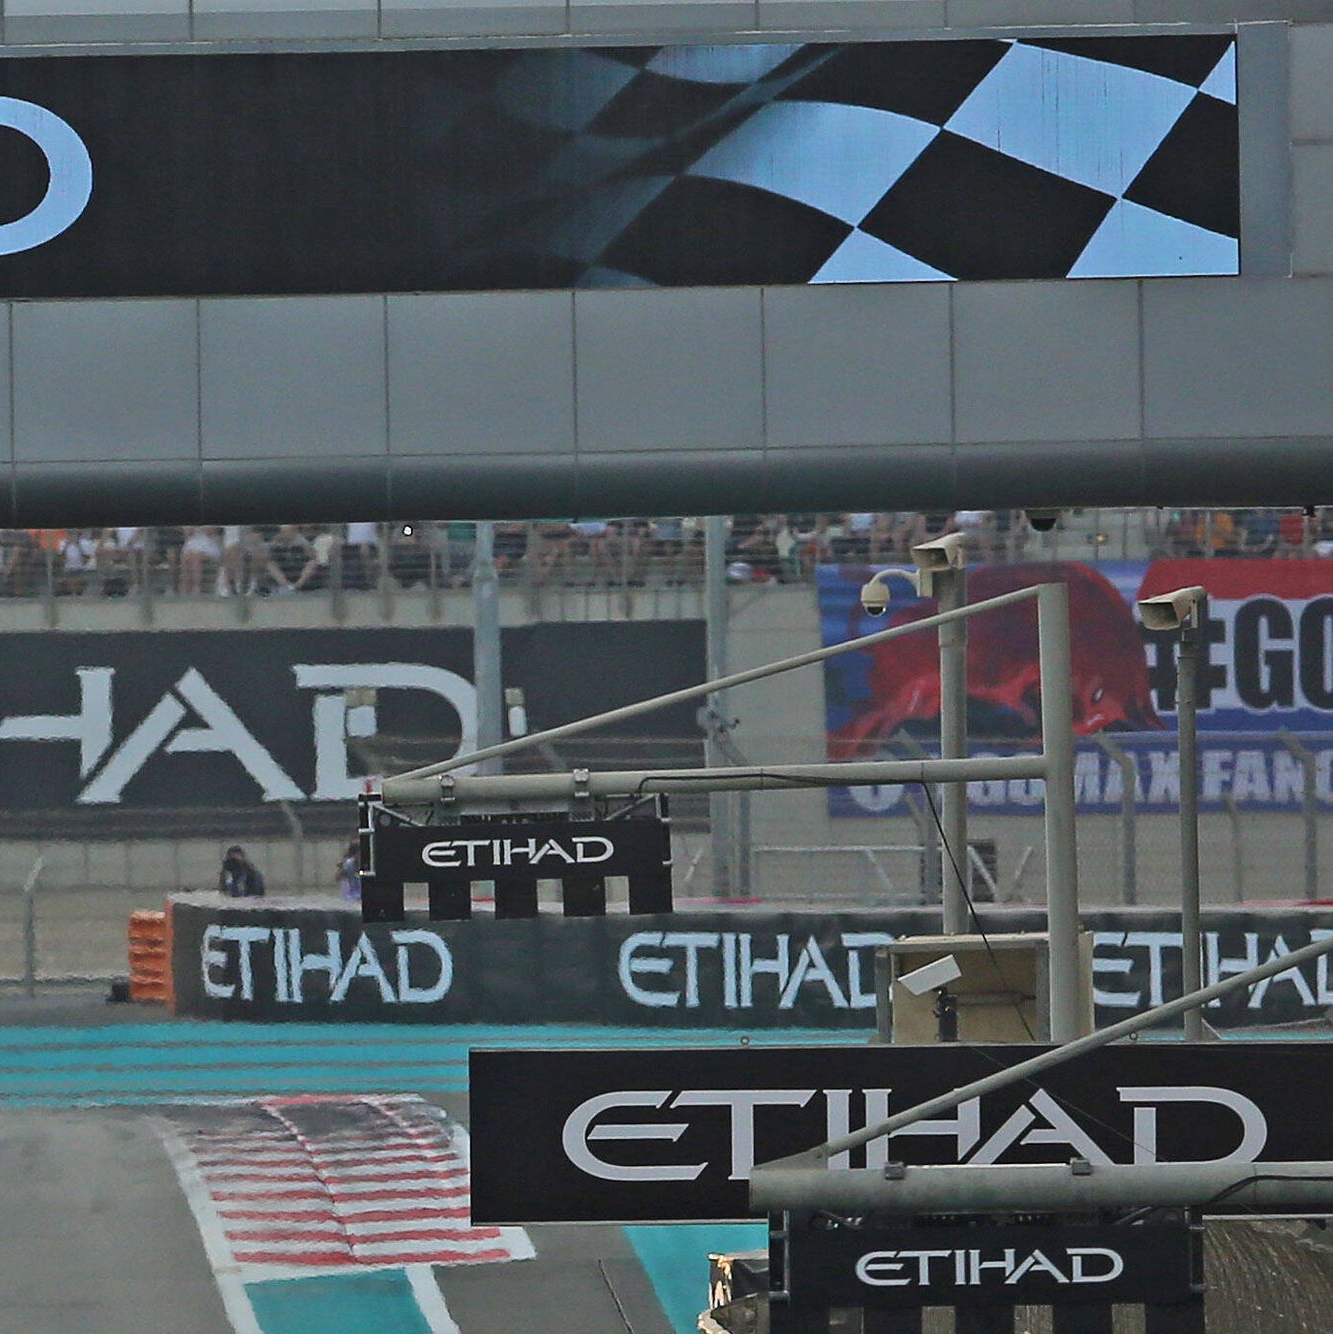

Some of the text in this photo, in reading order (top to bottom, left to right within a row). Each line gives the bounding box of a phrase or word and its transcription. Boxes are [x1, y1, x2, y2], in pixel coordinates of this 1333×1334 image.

[422, 836, 615, 867] ETIHAD
[201, 922, 454, 1005] ETIHAD
[561, 1085, 1269, 1182] ETIHAD
[854, 1247, 1124, 1287] ETIHAD
